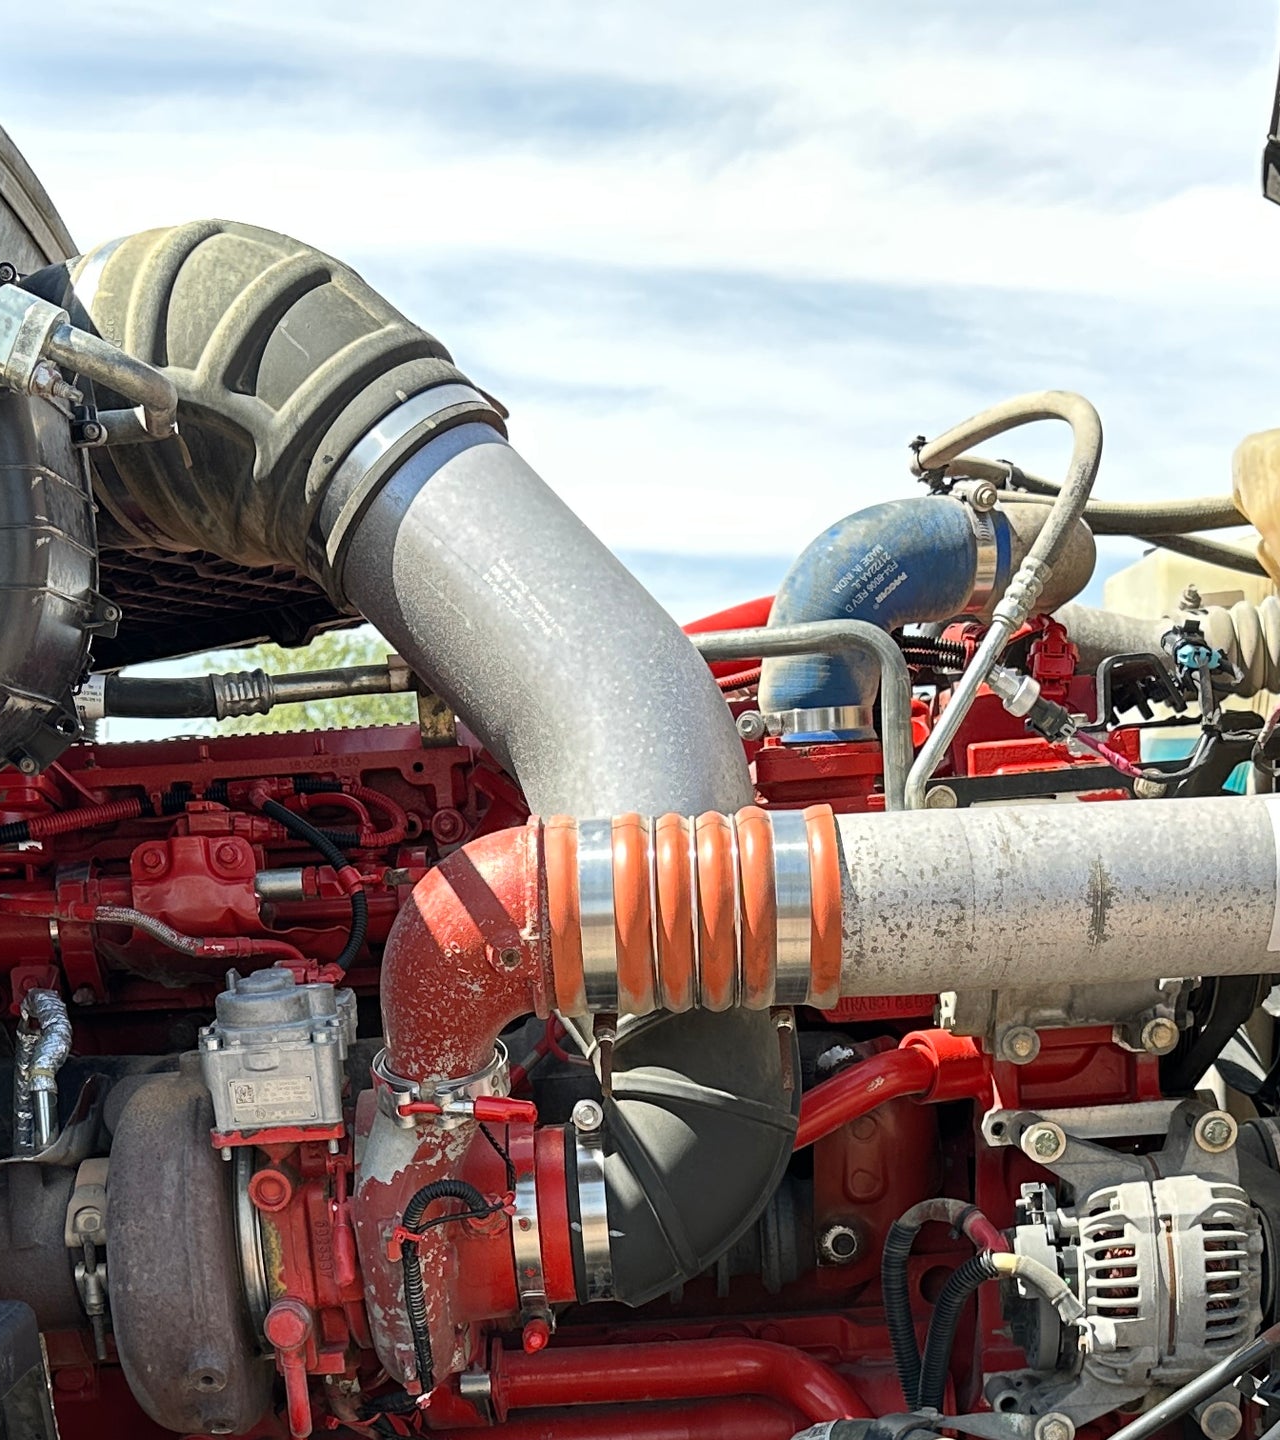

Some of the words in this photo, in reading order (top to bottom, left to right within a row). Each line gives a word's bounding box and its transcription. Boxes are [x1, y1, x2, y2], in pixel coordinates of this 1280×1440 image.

[859, 543, 884, 568] MADE
[831, 572, 855, 594] INDIA
[875, 571, 908, 604] PACCAR
